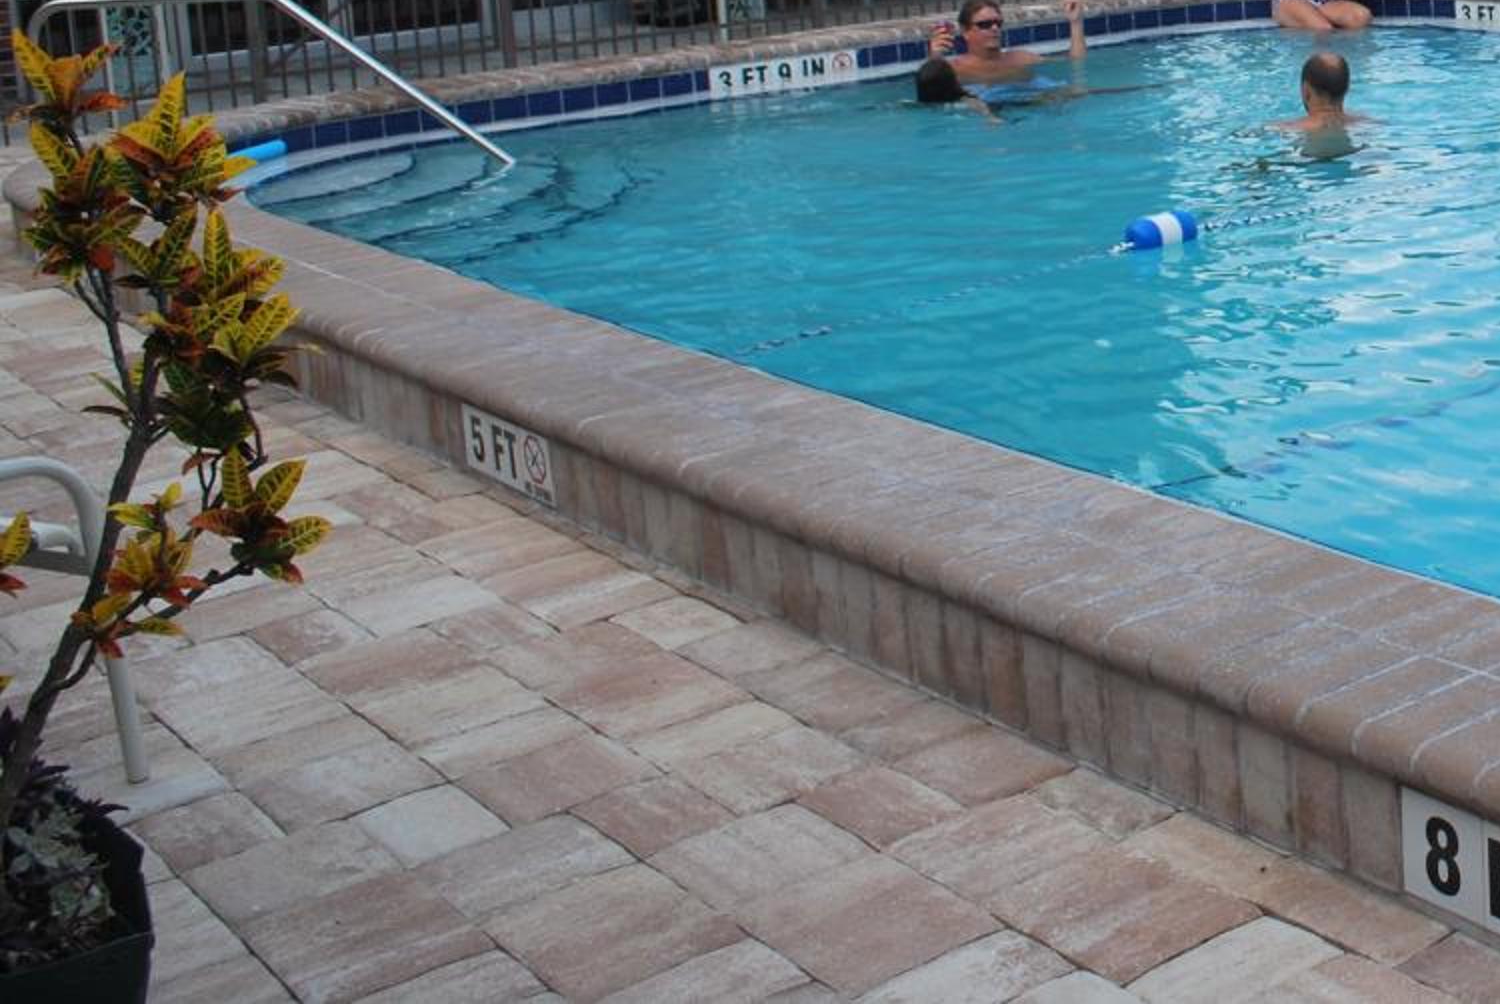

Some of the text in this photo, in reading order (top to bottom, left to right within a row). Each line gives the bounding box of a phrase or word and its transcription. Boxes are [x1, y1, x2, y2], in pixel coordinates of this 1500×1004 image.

[1478, 6, 1495, 21] FT
[742, 66, 768, 85] FT
[802, 57, 825, 77] IN
[470, 415, 517, 480] 5 FT
[1425, 816, 1461, 897] 8
